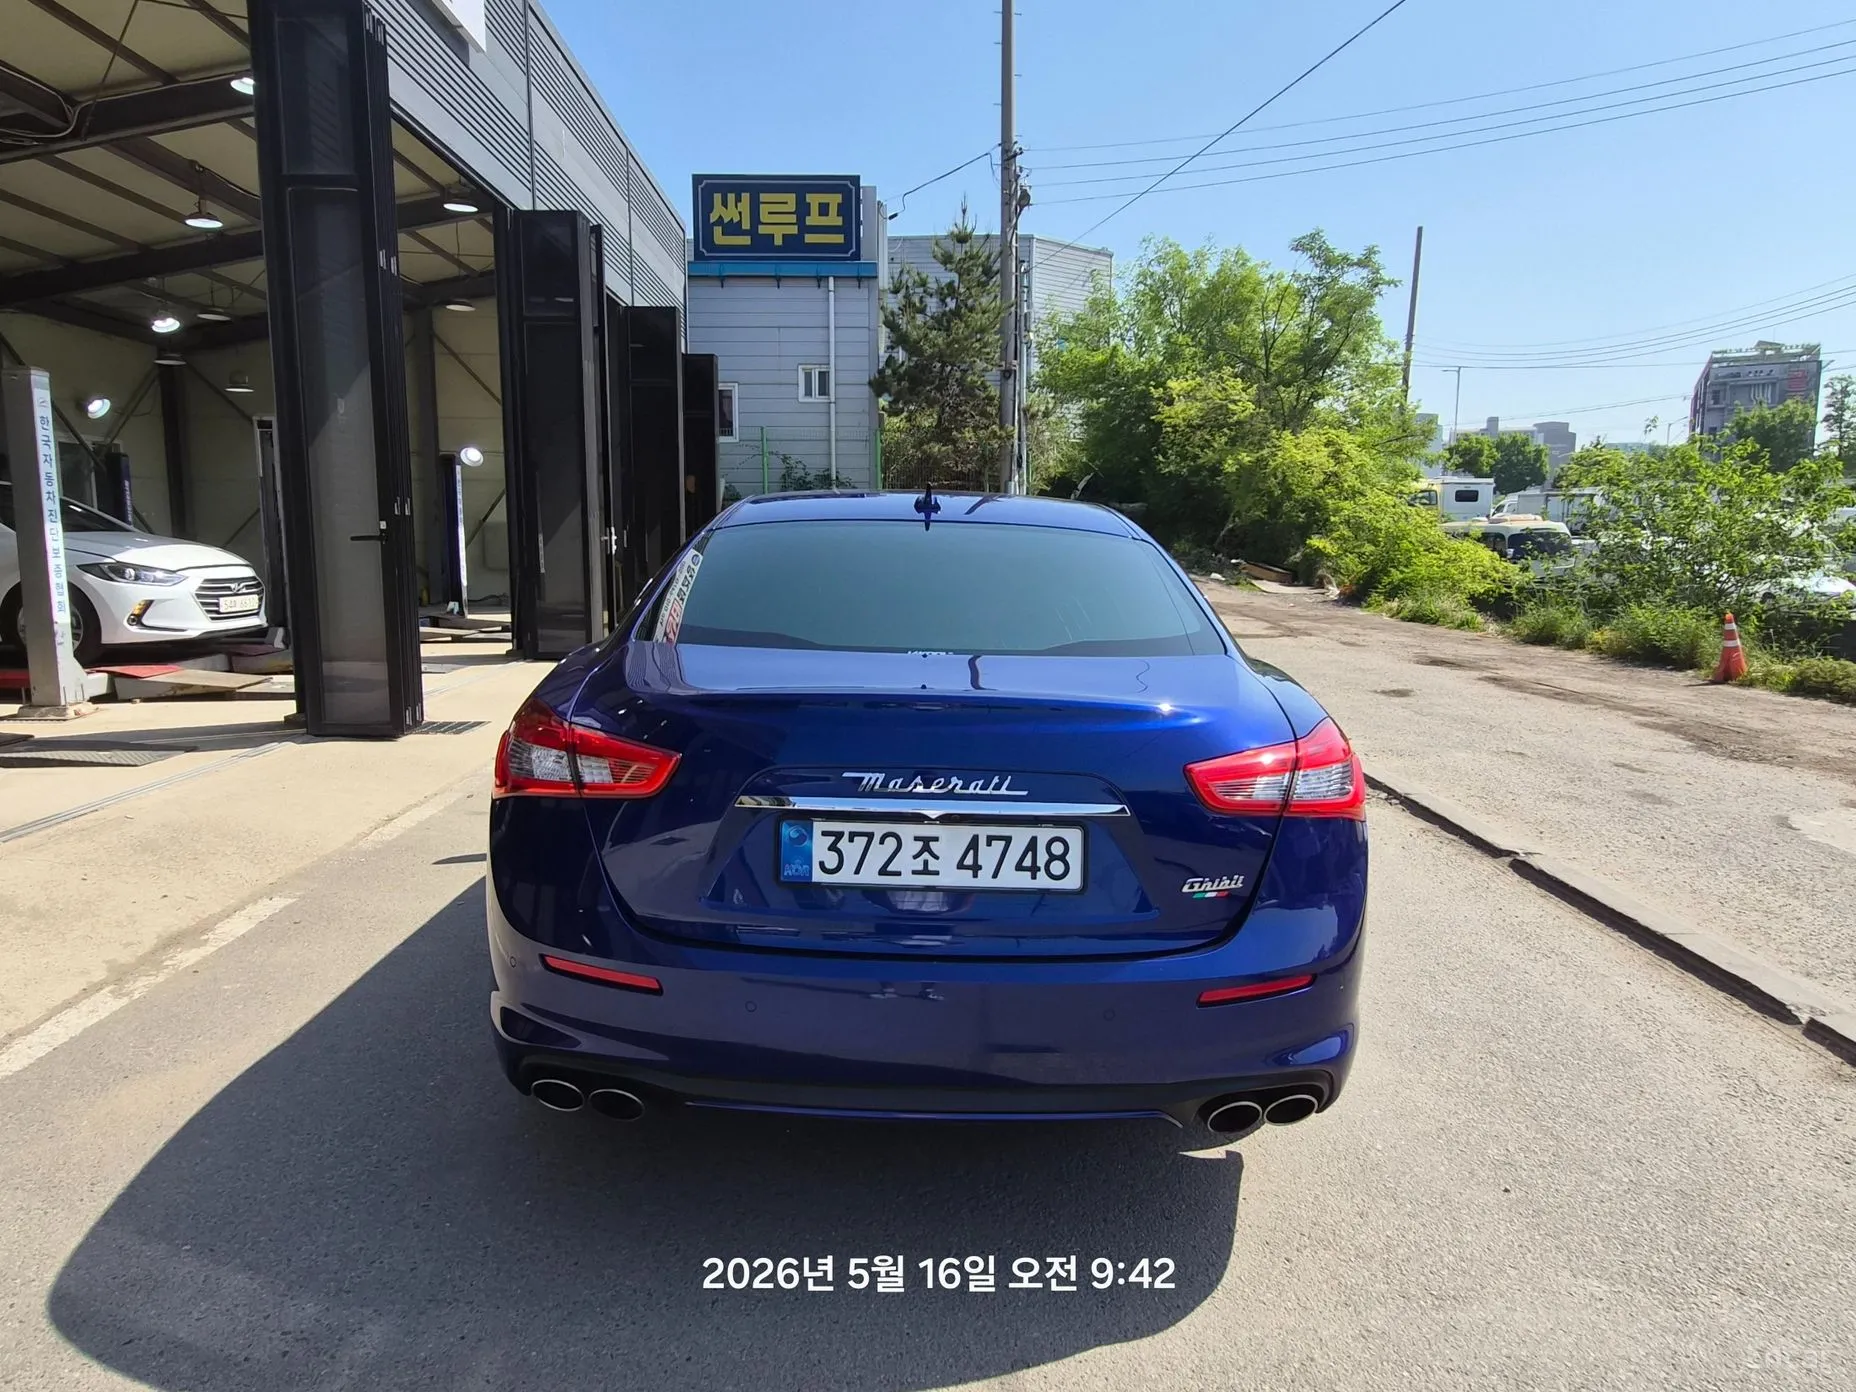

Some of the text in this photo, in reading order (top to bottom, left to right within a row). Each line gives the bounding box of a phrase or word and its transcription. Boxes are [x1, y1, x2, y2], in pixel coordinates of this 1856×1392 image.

[710, 193, 844, 246] 썬루프
[841, 772, 1028, 796] Maserati
[818, 830, 1071, 882] 372조 4748
